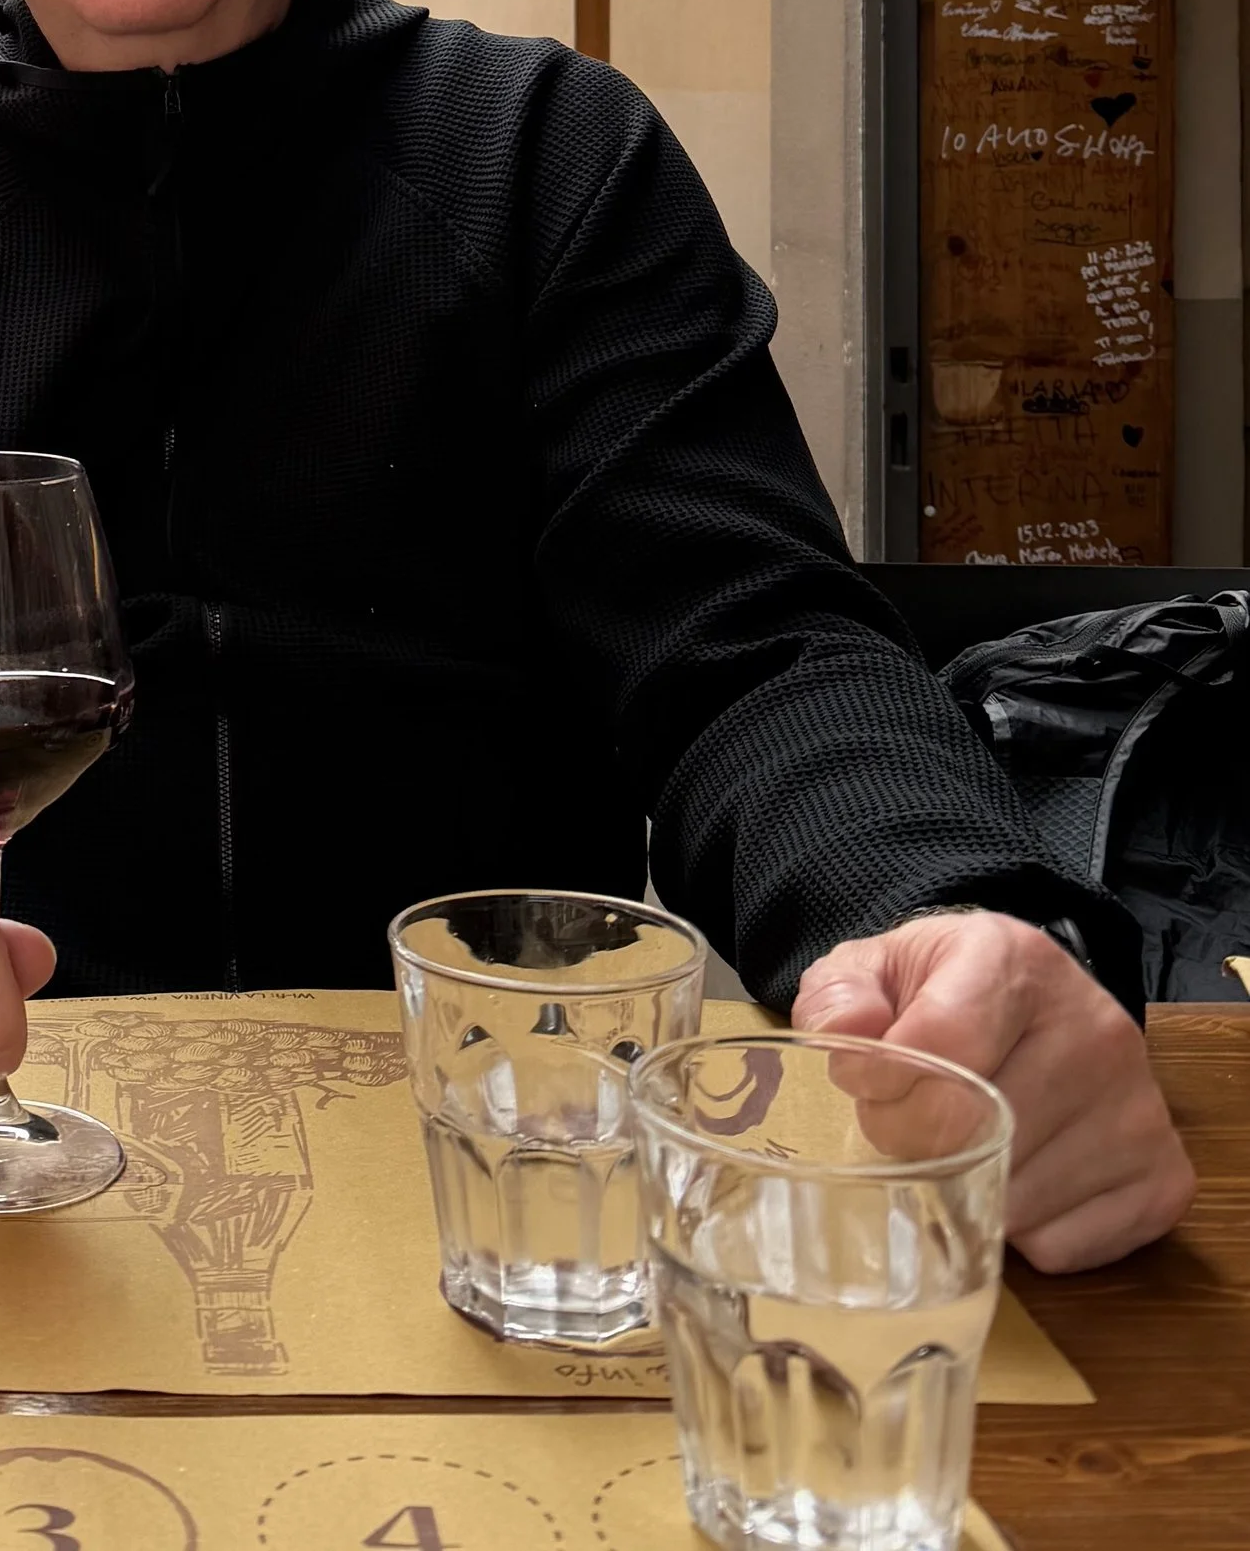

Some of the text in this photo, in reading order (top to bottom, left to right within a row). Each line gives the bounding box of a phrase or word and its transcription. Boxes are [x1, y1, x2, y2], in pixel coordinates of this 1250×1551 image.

[928, 468, 1109, 508] INTERNA
[1017, 519, 1100, 544] 15.12.2023
[554, 1364, 644, 1387] info
[2, 1503, 82, 1551] 3
[361, 1505, 463, 1551] 4
